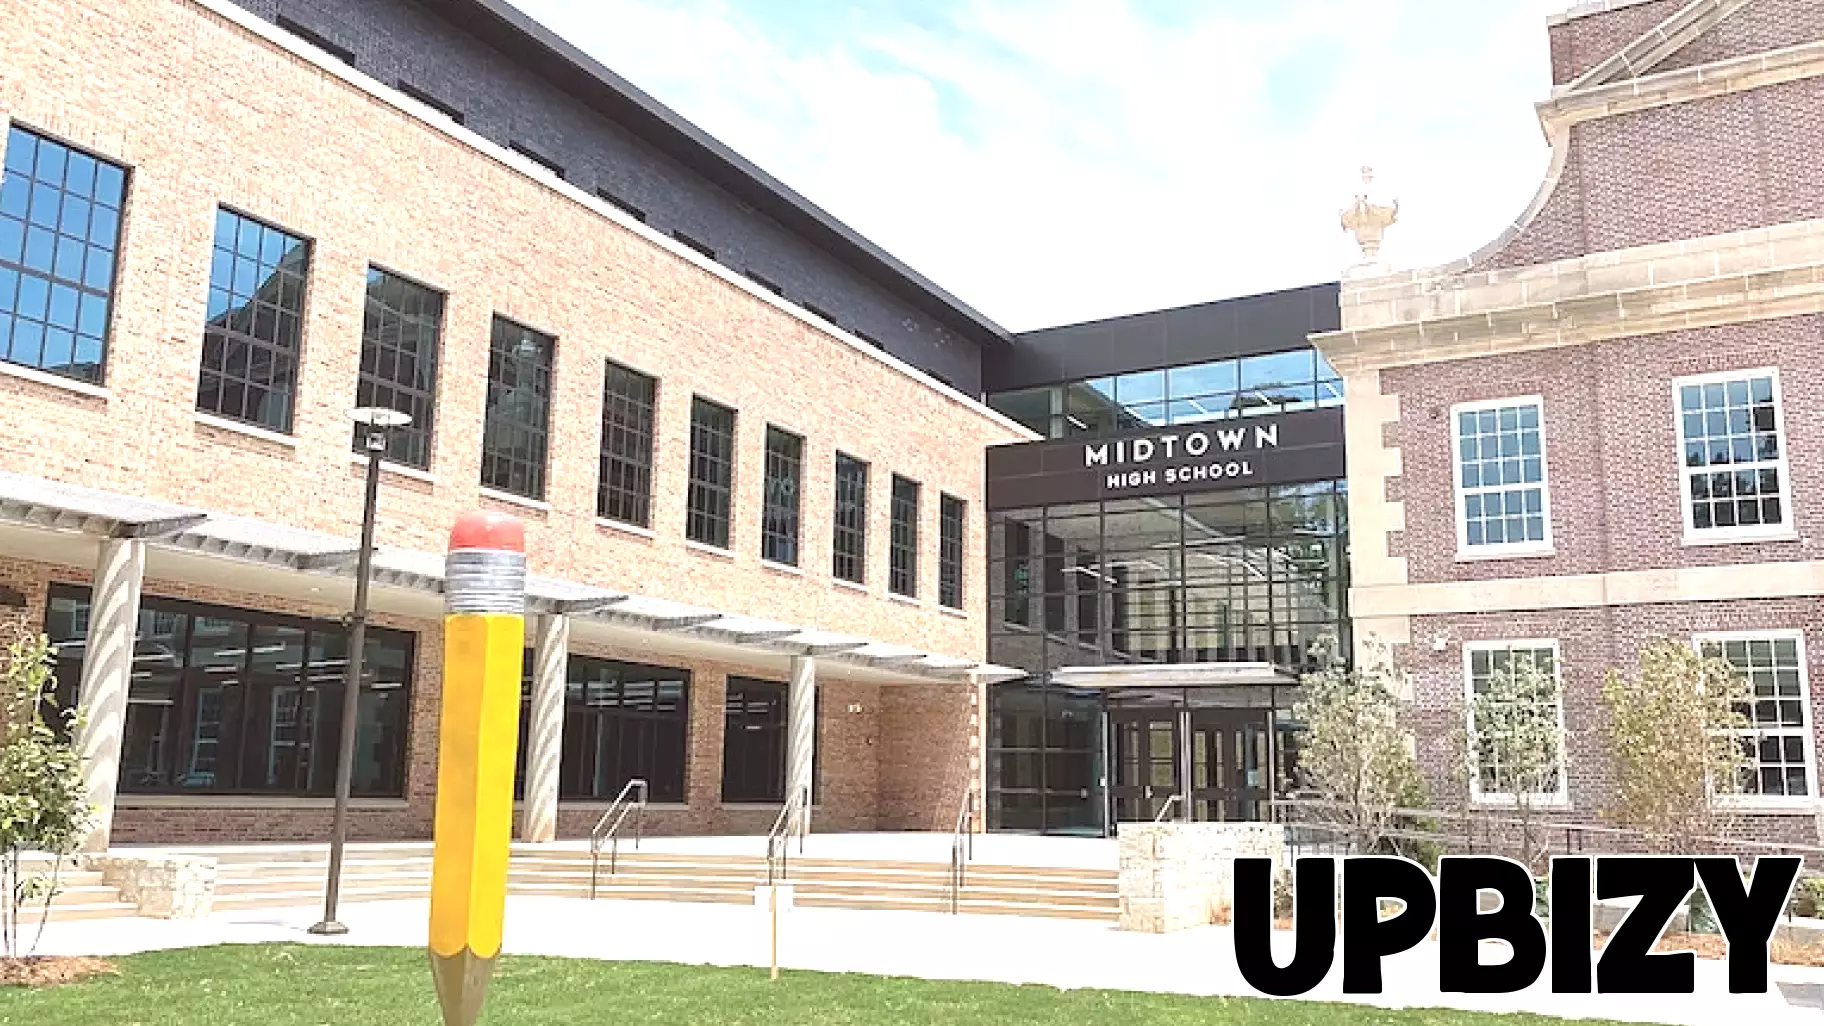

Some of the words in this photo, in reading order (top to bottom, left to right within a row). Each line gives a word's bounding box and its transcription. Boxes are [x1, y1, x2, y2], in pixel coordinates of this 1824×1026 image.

[1085, 424, 1278, 466] MIDTOWN
[1106, 471, 1156, 489] HIGH
[1165, 461, 1253, 484] SCHOOL
